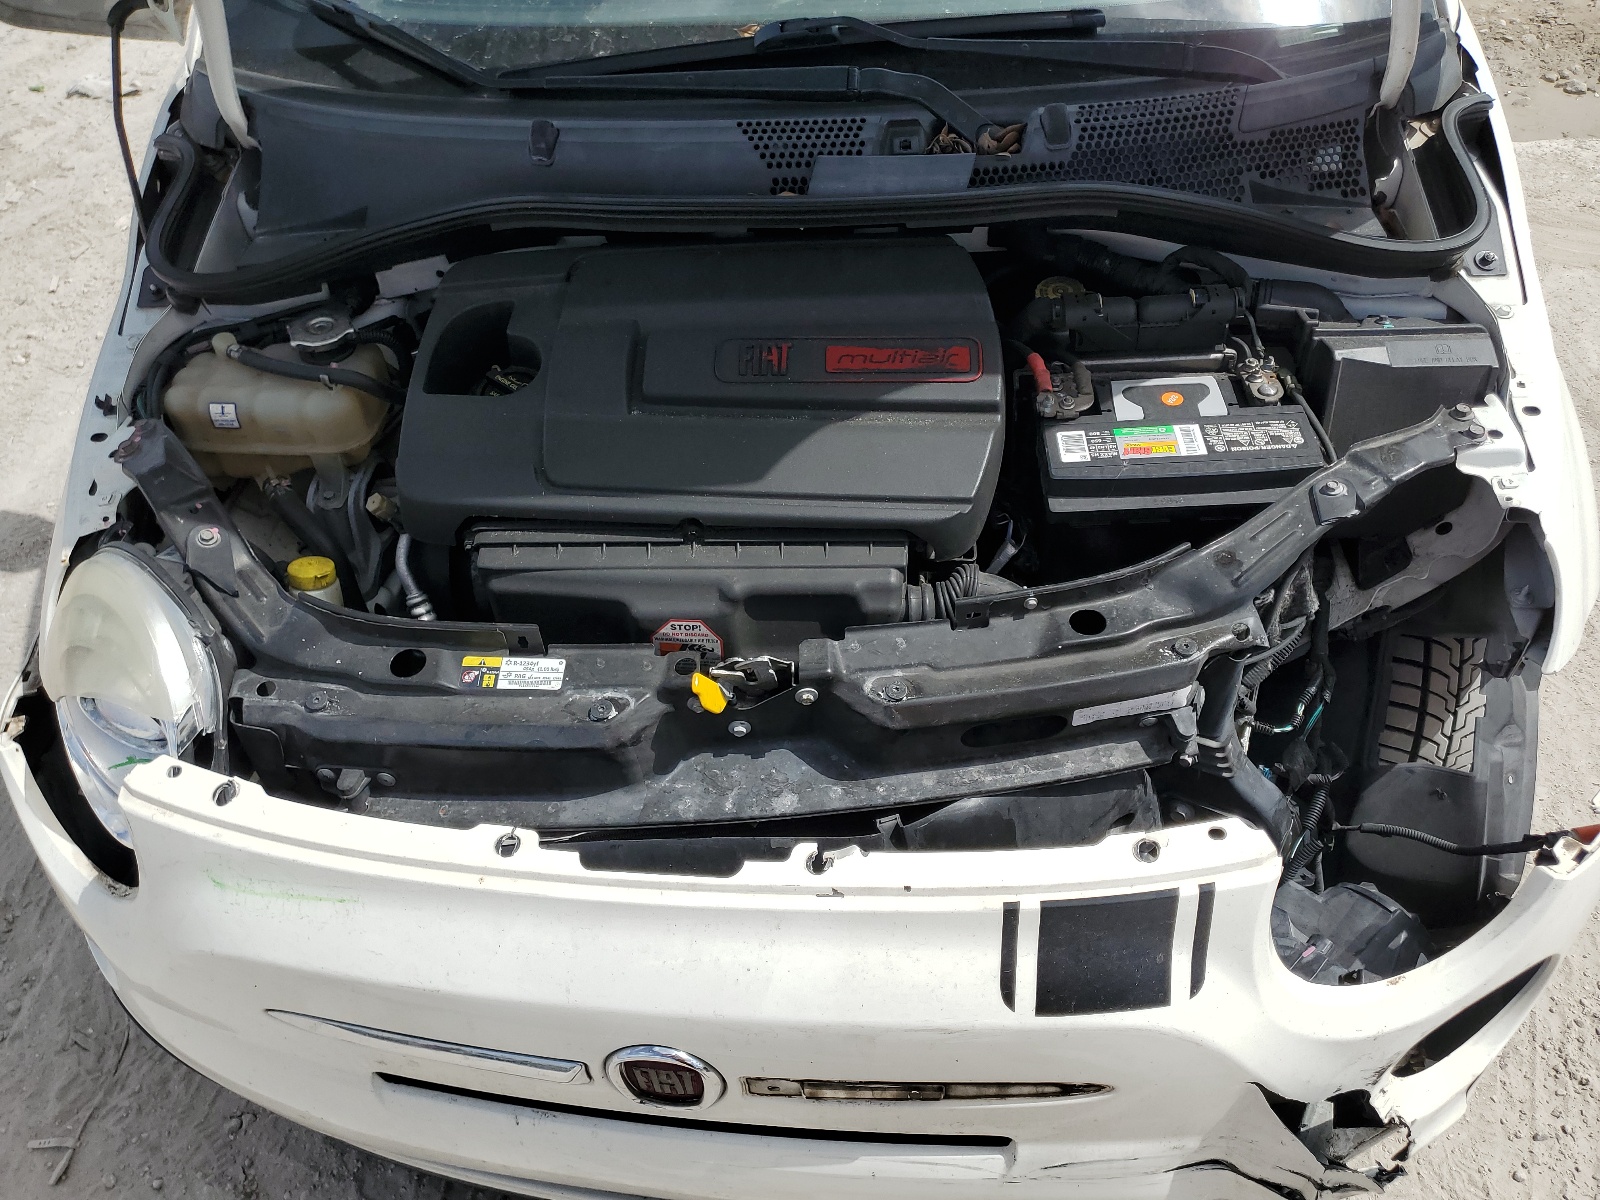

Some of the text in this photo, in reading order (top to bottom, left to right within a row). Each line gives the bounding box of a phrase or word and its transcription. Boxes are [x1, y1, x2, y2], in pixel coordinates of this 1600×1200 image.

[738, 342, 792, 377] FIAT
[836, 349, 960, 366] multiair
[670, 623, 701, 631] STOP!
[632, 1066, 695, 1095] FIAT
